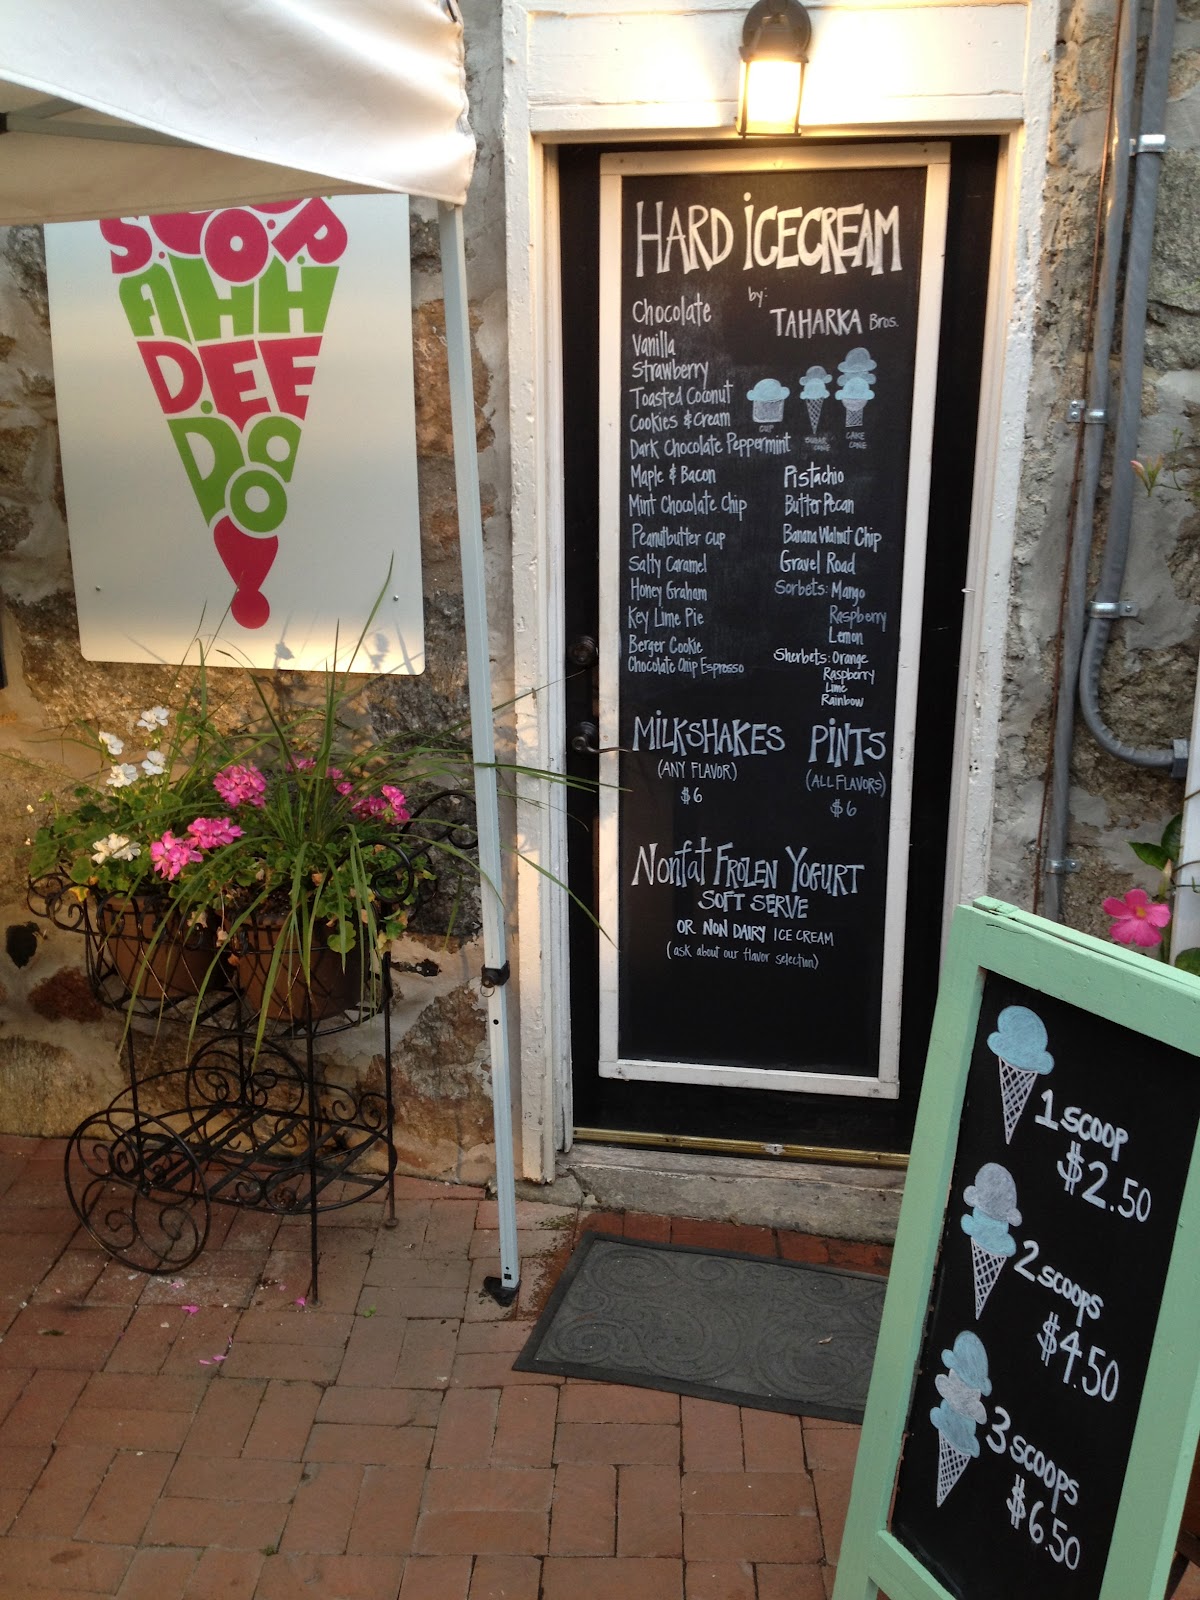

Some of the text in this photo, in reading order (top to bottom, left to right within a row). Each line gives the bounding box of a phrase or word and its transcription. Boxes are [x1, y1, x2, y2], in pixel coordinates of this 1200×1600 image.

[636, 201, 734, 277] HARD
[119, 253, 340, 344] AHH
[632, 293, 712, 326] Chocolate
[748, 287, 768, 308] by:
[770, 308, 899, 338] TAHARKA Bros.
[632, 330, 676, 358] Vanilla
[136, 336, 322, 433] DEE
[632, 358, 709, 390] Strawberry
[629, 379, 733, 409] Toasted Coconut
[630, 410, 731, 434] Cookies & Cream
[630, 432, 791, 460] Dark Chocolate Peppermint
[630, 463, 716, 492] Maple & Bacon
[783, 461, 844, 488] Pistachio
[628, 489, 748, 521] Mint Chocolate Chip
[785, 492, 855, 518] Butter Pecan
[632, 523, 701, 549] Peanutbutter
[783, 523, 882, 553] Banana Walnut Chip
[628, 553, 708, 578] Salty Caramel
[780, 549, 856, 575] Gravel Road
[631, 577, 708, 607] Honey Graham
[774, 577, 866, 607] Sorbets: Mango
[628, 606, 704, 634] Key Lime Pie
[829, 605, 887, 632] Raspberry
[628, 634, 704, 658] Berger Cookie
[828, 626, 864, 645] Lemon
[628, 655, 676, 674] Chocolate
[677, 657, 699, 679] Chip
[773, 648, 869, 669] Sherbets: Orange
[823, 667, 875, 685] Raspberry
[825, 681, 848, 693] Lime
[821, 693, 864, 707] Rainbow
[657, 759, 738, 781] (ANY FLAVOR)
[805, 769, 886, 798] (ALL FLAVORS)
[680, 787, 703, 805] $6
[829, 799, 857, 818] $6
[631, 836, 865, 897] Nonfat FROZEN YOGURT
[698, 890, 809, 919] SOFT SERVE
[676, 918, 834, 947] OR NON DAIRY ICE CREAM
[666, 941, 819, 970] (ask about our flavor selection)
[1034, 1089, 1059, 1131] 1
[1056, 1140, 1152, 1223] $2.50
[1013, 1239, 1040, 1282] 2
[1036, 1311, 1120, 1402] $4.50
[985, 1406, 1011, 1454] 3
[1006, 1473, 1080, 1570] $6.50
